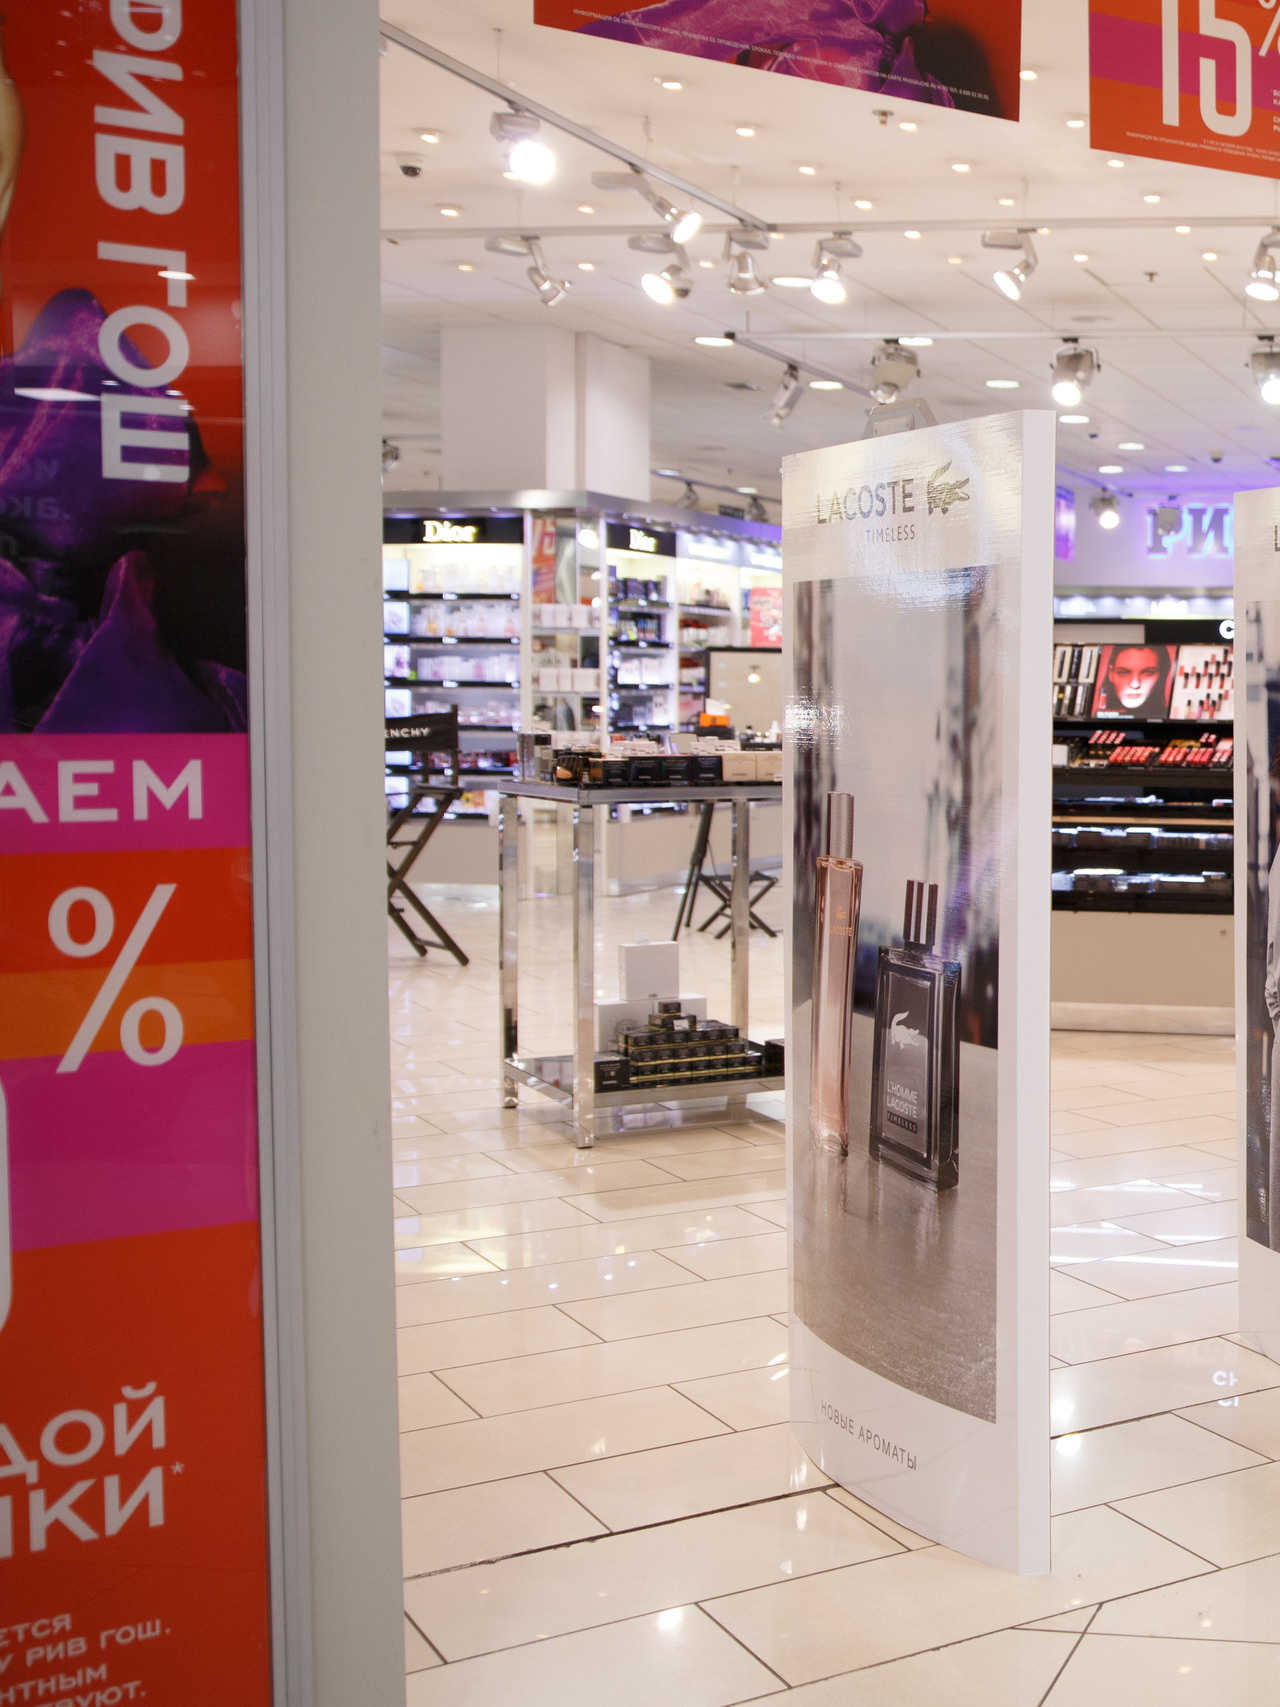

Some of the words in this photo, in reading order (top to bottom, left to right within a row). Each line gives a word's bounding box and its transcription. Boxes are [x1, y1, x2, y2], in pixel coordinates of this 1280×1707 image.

[97, 241, 190, 482] ГОШ
[816, 478, 915, 524] LACOSTE
[422, 520, 477, 542] Dior
[866, 524, 915, 543] TIMELESS
[887, 1080, 918, 1104] L'HOMME
[887, 1095, 918, 1119] LACOSTE
[821, 1400, 854, 1435] НОВЫЕ
[858, 1426, 917, 1471] АРОМАТЫ
[26, 1637, 87, 1668] РИВ
[100, 1619, 171, 1649] ГОШ.
